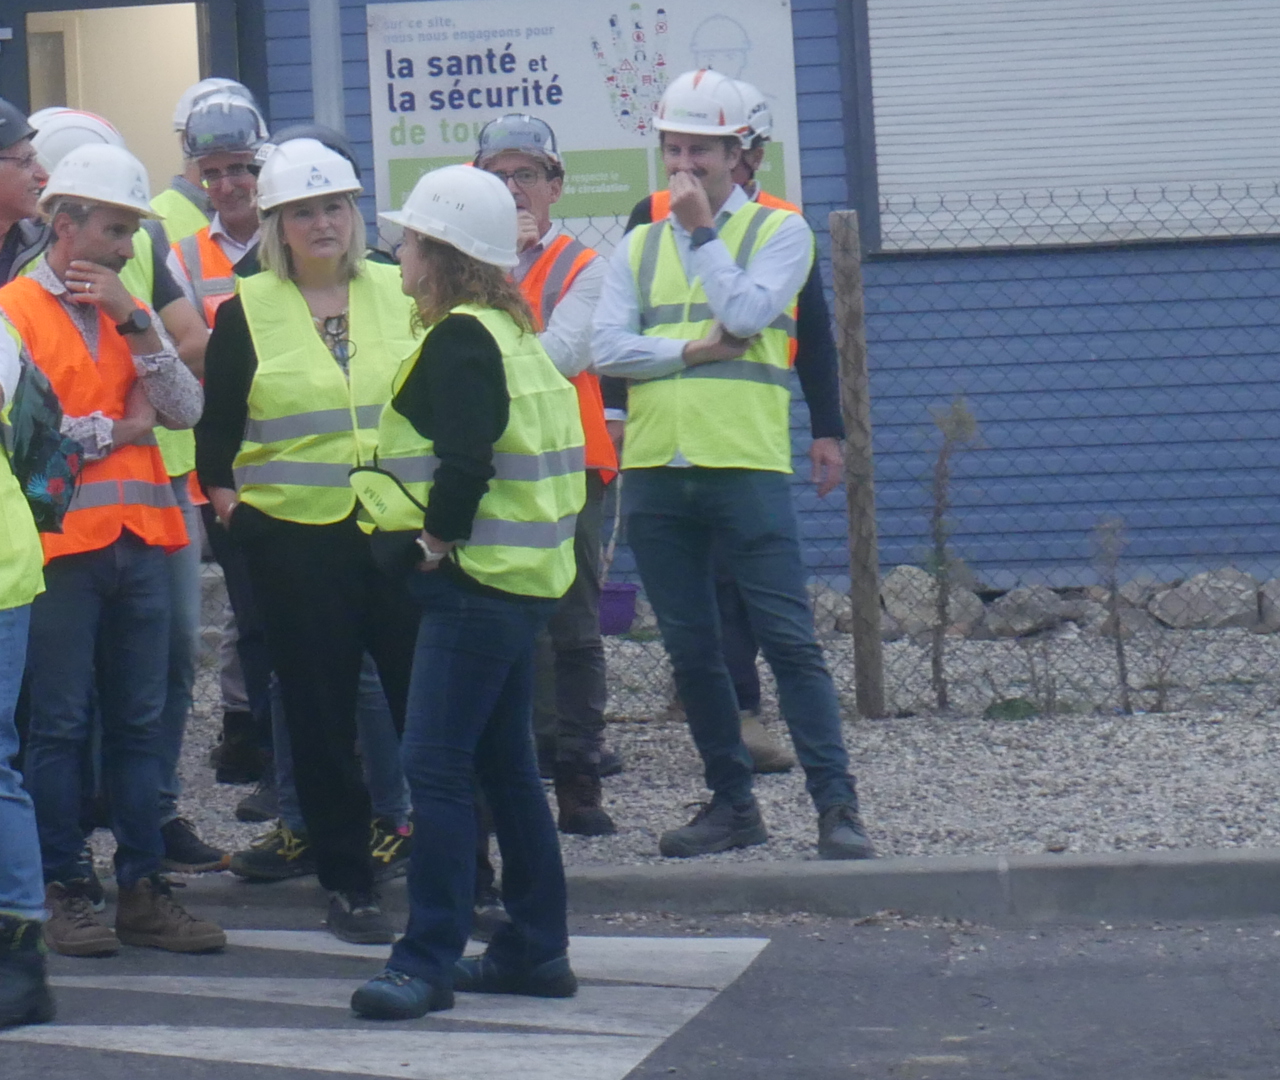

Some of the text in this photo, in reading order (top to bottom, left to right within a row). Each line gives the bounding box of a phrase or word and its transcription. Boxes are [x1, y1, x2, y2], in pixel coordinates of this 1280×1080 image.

[407, 18, 423, 29] ce
[418, 31, 449, 42] nous
[452, 28, 522, 42] engageons
[525, 25, 556, 40] pour
[385, 42, 549, 79] la santé et
[387, 73, 564, 113] la sécurité
[388, 116, 427, 147] de
